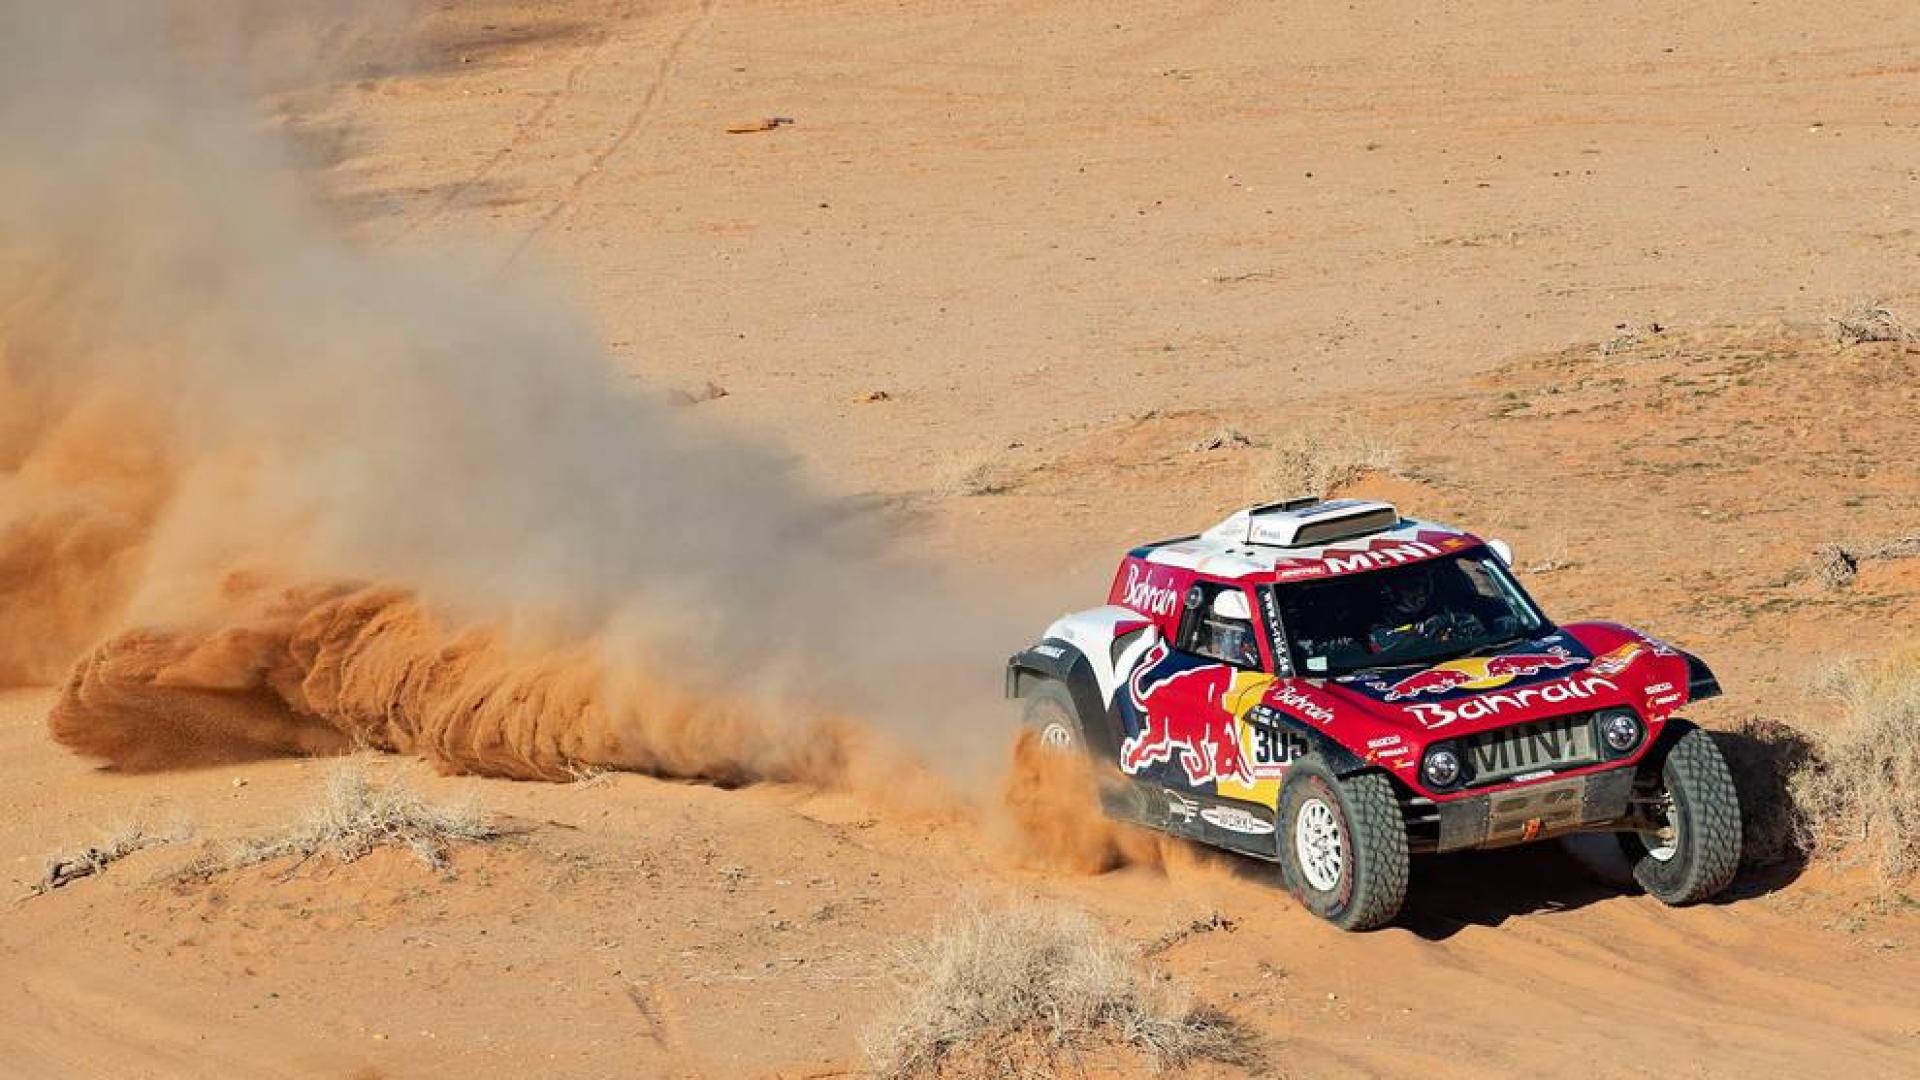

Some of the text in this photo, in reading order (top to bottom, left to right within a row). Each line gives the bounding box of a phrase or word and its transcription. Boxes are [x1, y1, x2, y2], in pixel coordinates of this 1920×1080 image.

[1323, 542, 1441, 575] MINI
[1123, 563, 1178, 617] Bahrain
[1272, 684, 1335, 724] Bahrain
[1402, 677, 1619, 730] Bahrain
